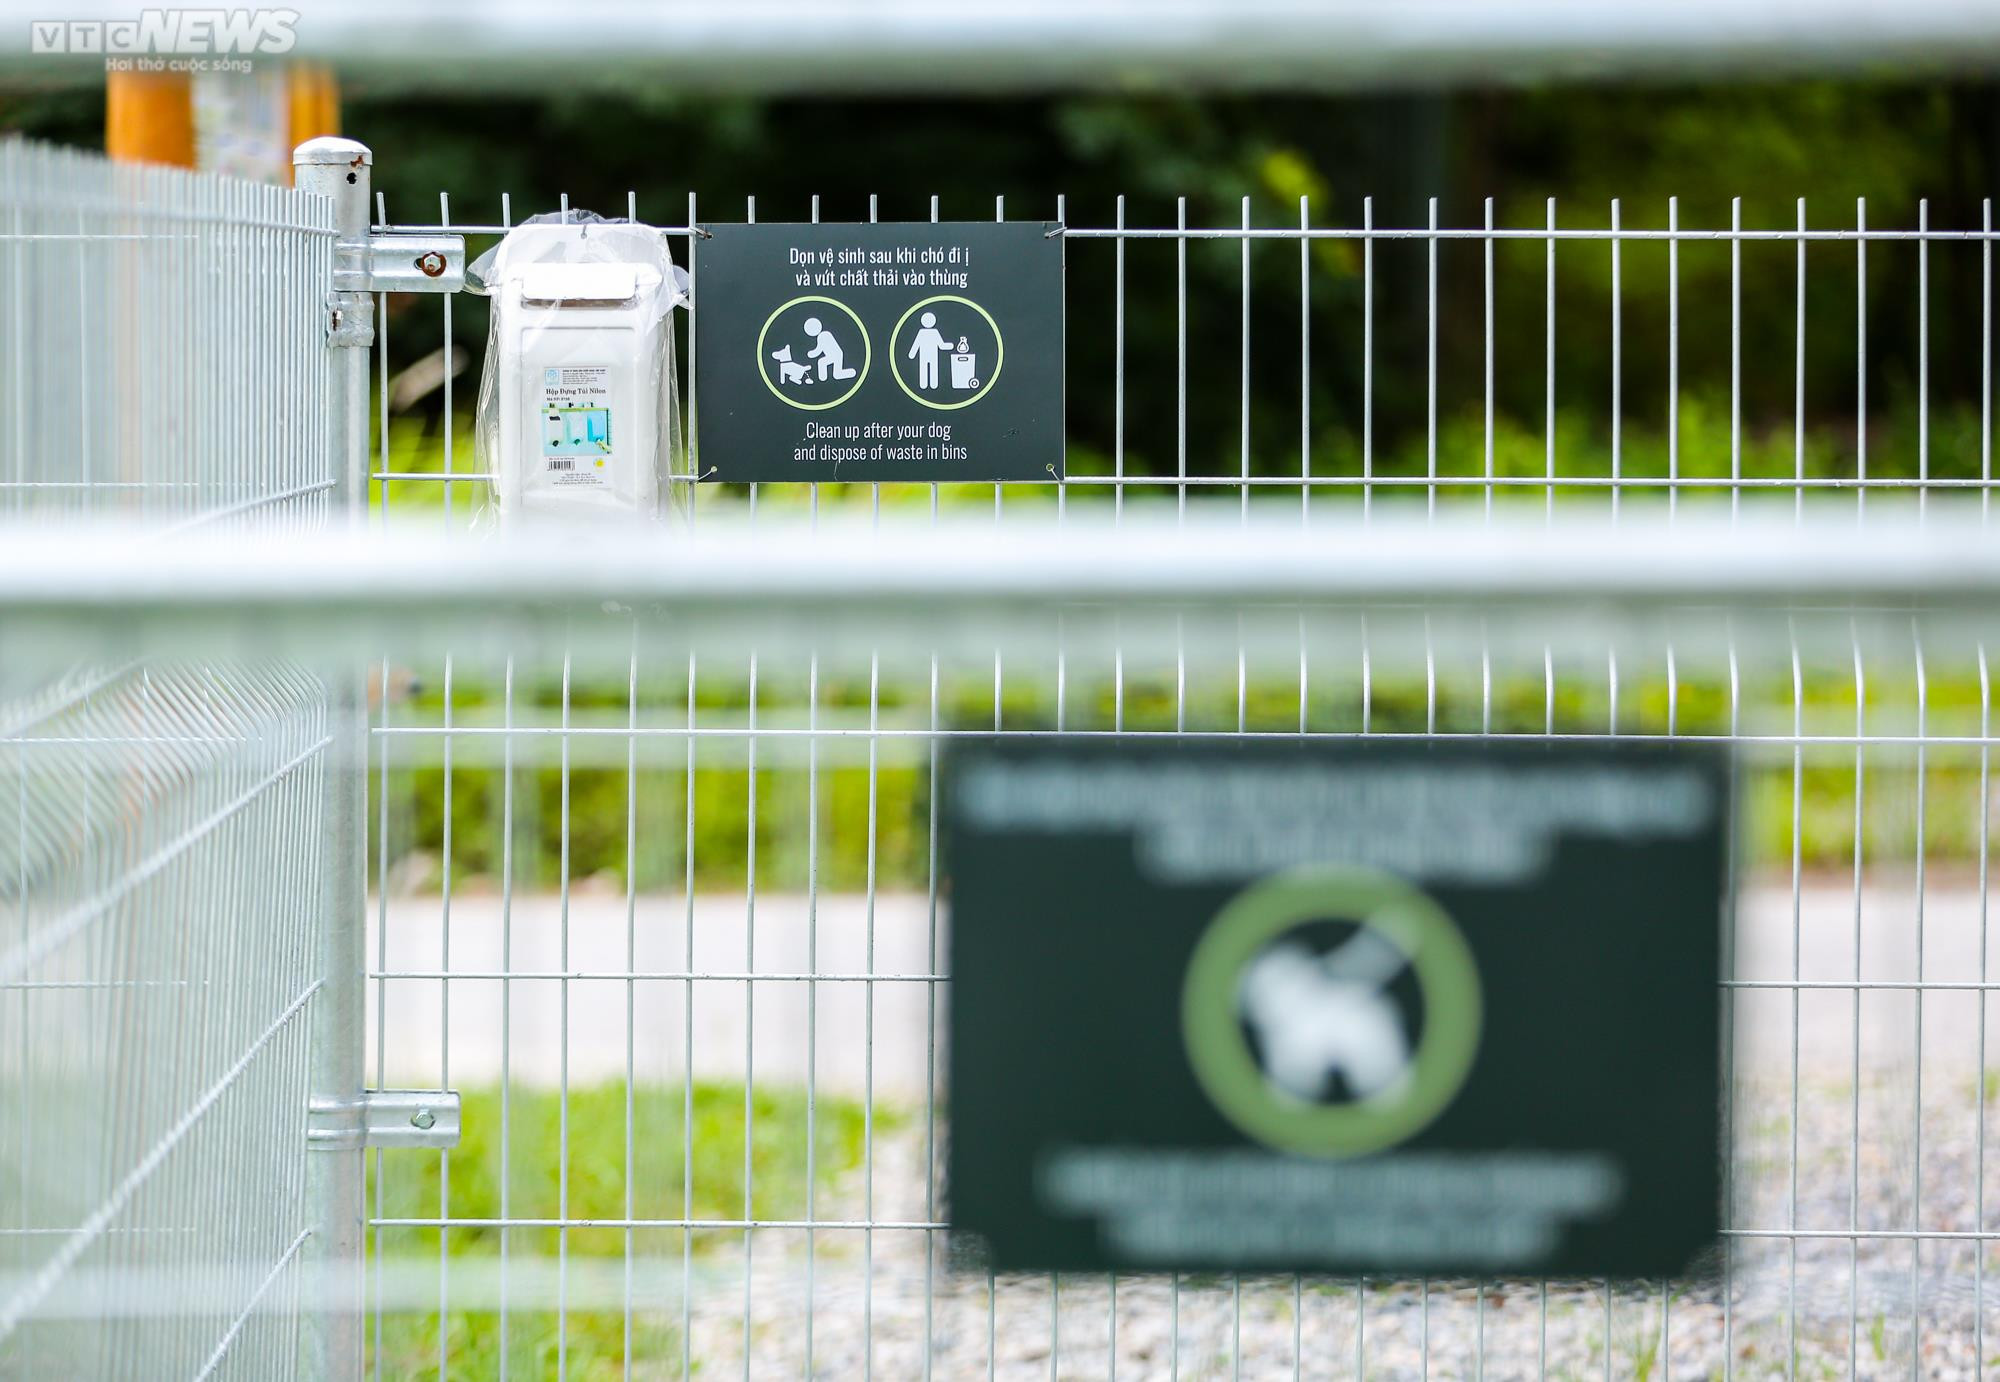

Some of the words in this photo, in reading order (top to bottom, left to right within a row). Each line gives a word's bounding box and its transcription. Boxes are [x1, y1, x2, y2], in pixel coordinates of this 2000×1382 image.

[789, 248, 815, 267] Dọn
[819, 248, 834, 267] vệ
[838, 248, 865, 264] sinh
[869, 251, 892, 264] sau
[897, 247, 916, 264] khi
[921, 247, 944, 264] chó
[949, 247, 961, 264] đi
[795, 270, 811, 286] và
[815, 269, 836, 286] vứt
[840, 268, 869, 286] chất
[873, 269, 898, 286] thải
[903, 269, 925, 286] vào
[930, 269, 968, 289] thùng
[806, 422, 841, 439] Clean
[845, 427, 860, 441] up
[863, 422, 894, 438] after
[897, 425, 924, 441] your
[928, 421, 951, 441] dog
[794, 444, 816, 461] and
[820, 444, 867, 463] dispose
[870, 444, 883, 460] of
[886, 445, 923, 460] waste
[927, 444, 938, 460] in
[941, 443, 968, 460] bins
